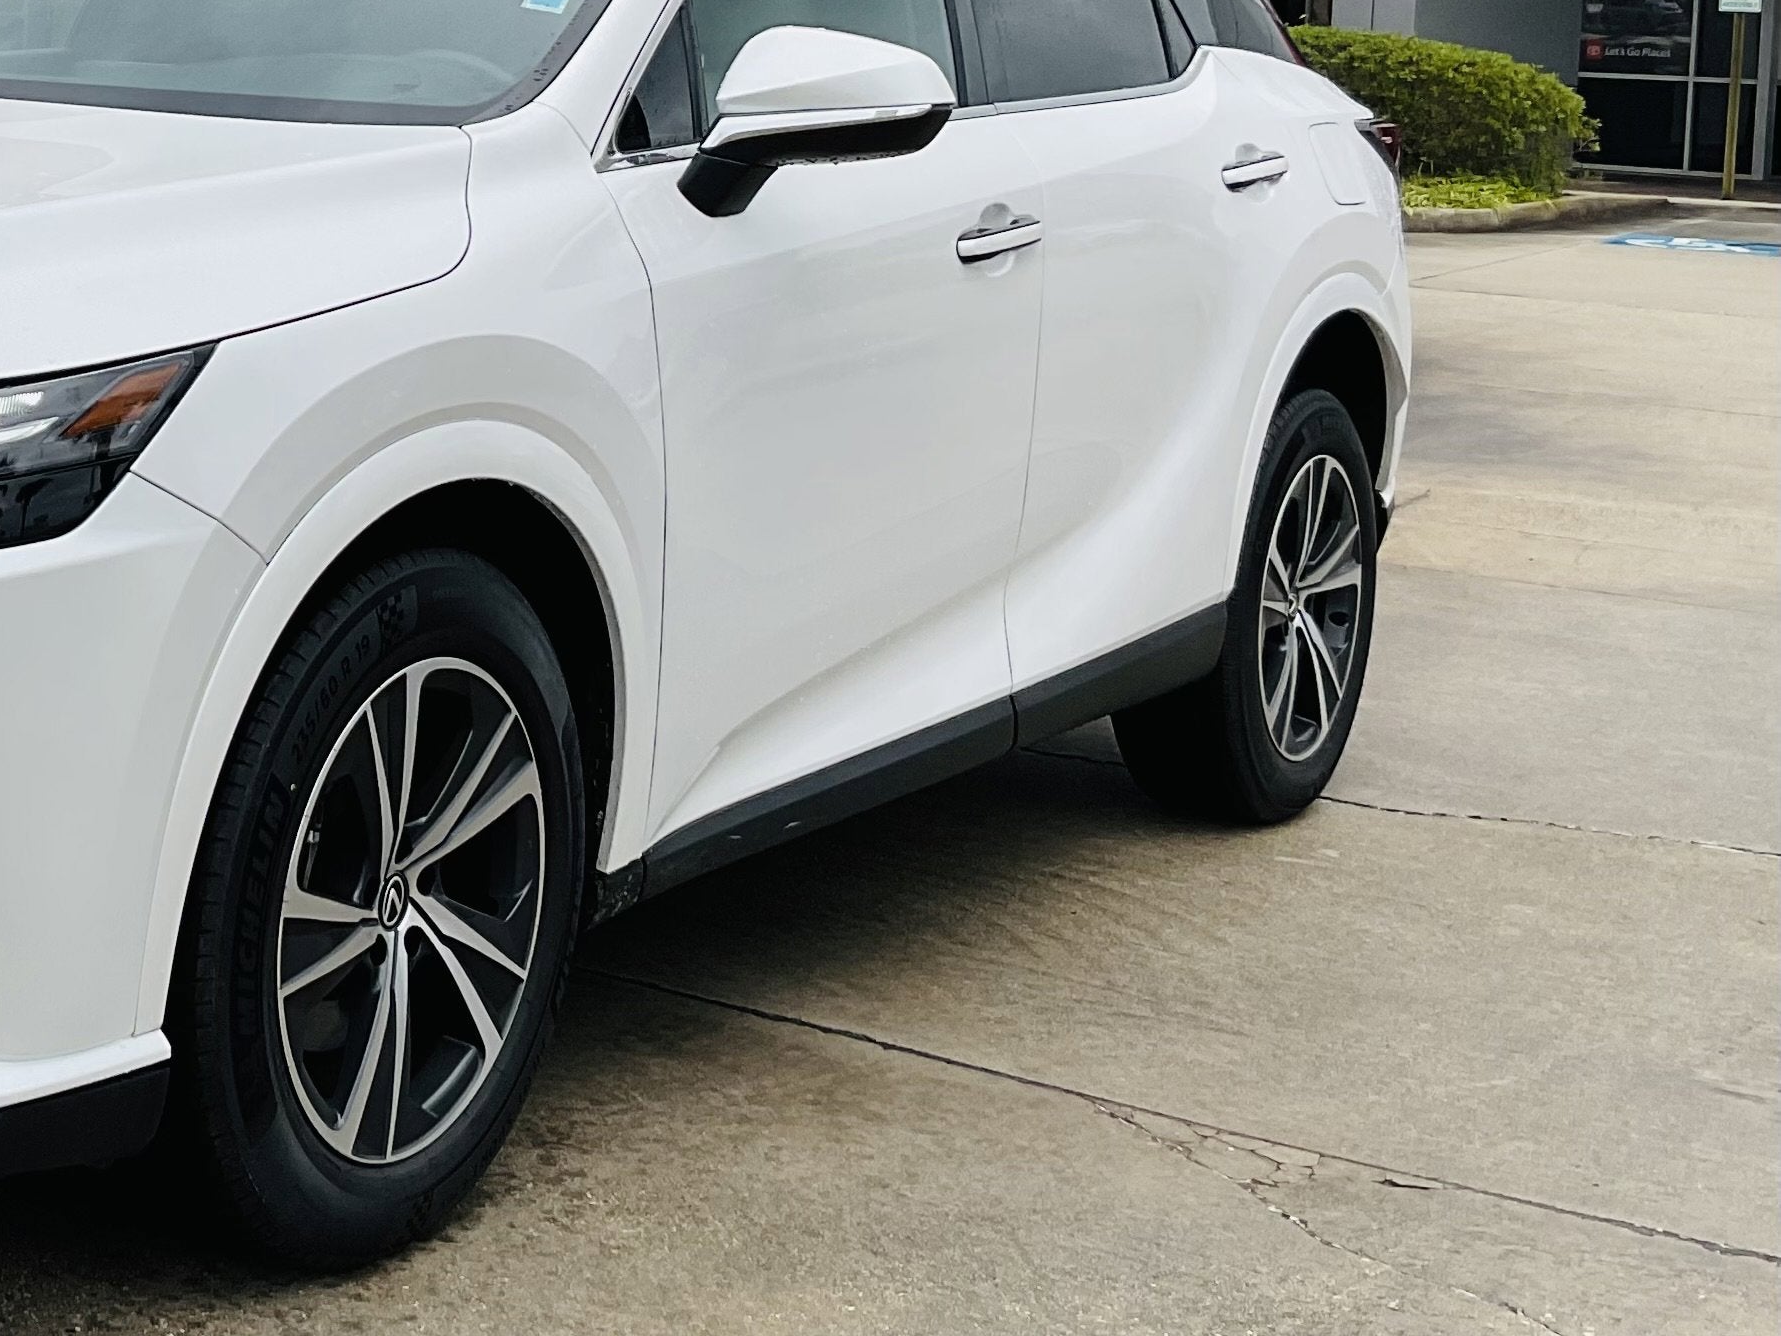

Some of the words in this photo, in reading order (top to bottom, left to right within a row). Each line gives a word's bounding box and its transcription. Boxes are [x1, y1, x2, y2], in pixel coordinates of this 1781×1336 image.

[1605, 46, 1625, 56] Let's
[1627, 47, 1641, 57] Go
[292, 674, 340, 765] 235/60
[355, 634, 371, 661] 19
[235, 789, 286, 1036] MICHELIN
